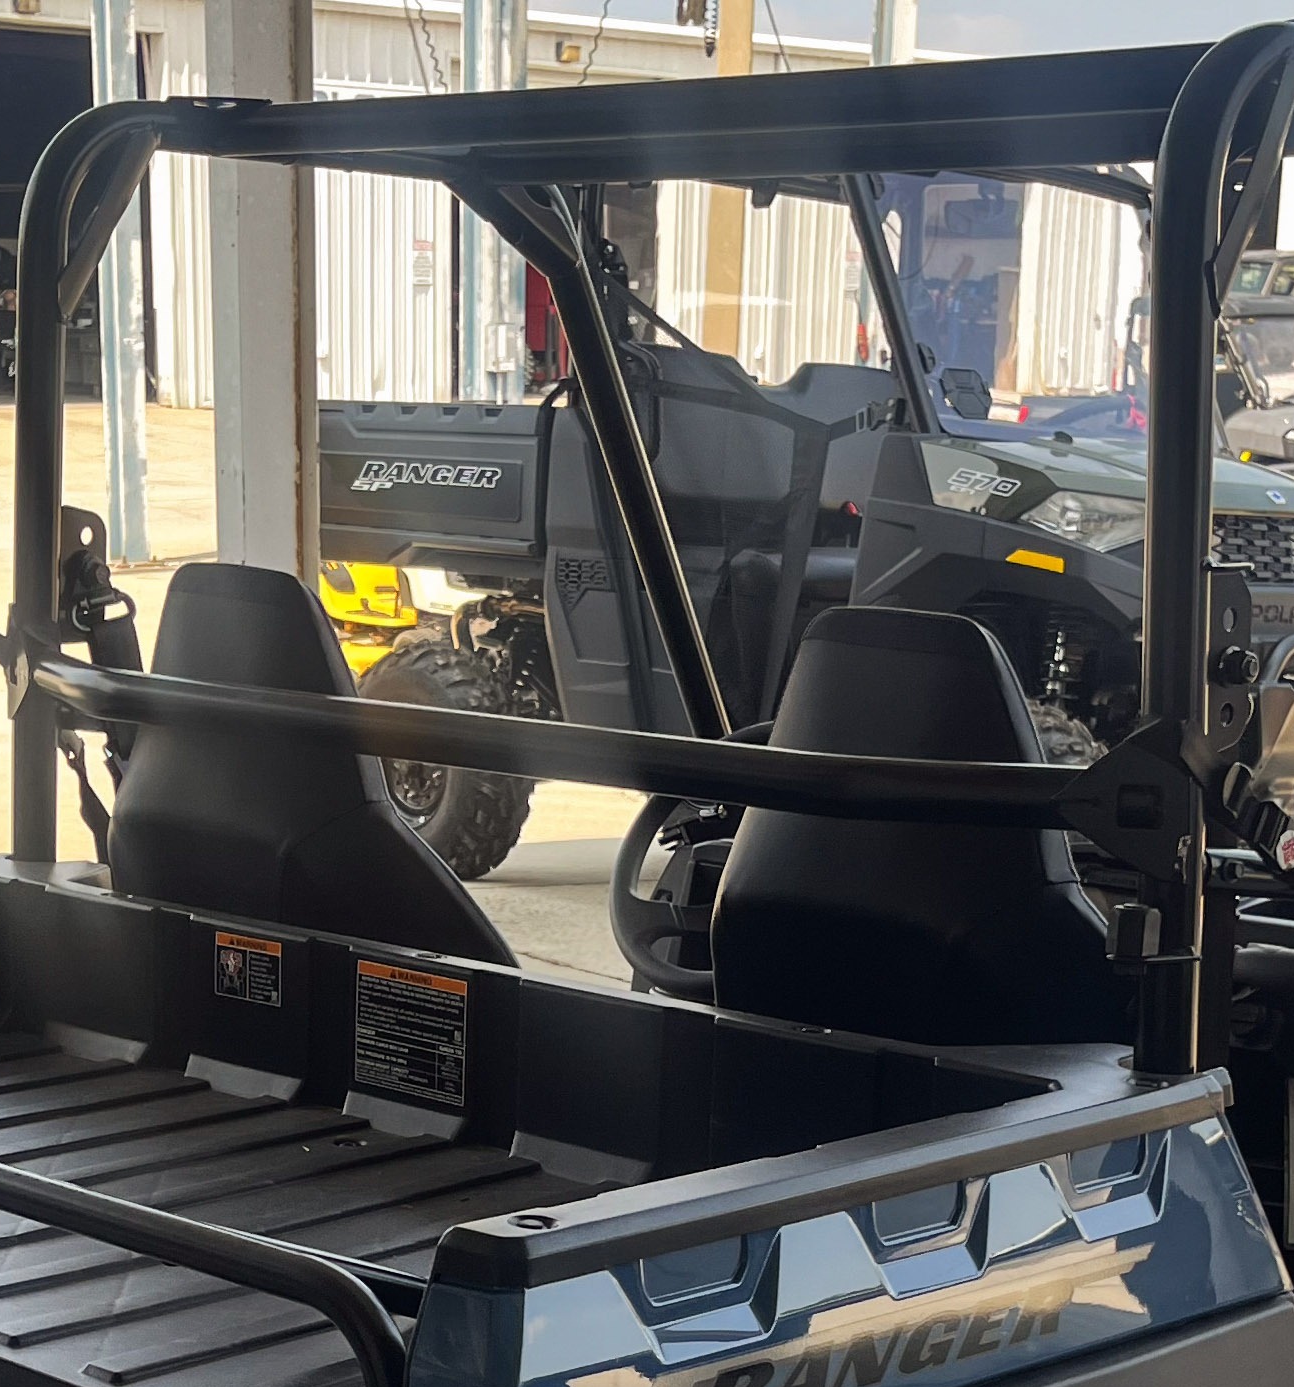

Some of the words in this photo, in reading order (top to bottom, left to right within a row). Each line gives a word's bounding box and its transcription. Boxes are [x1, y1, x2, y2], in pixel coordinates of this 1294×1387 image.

[351, 480, 394, 492] SP
[359, 461, 501, 489] RANGER
[947, 468, 1022, 498] 570
[399, 970, 433, 987] WARNING
